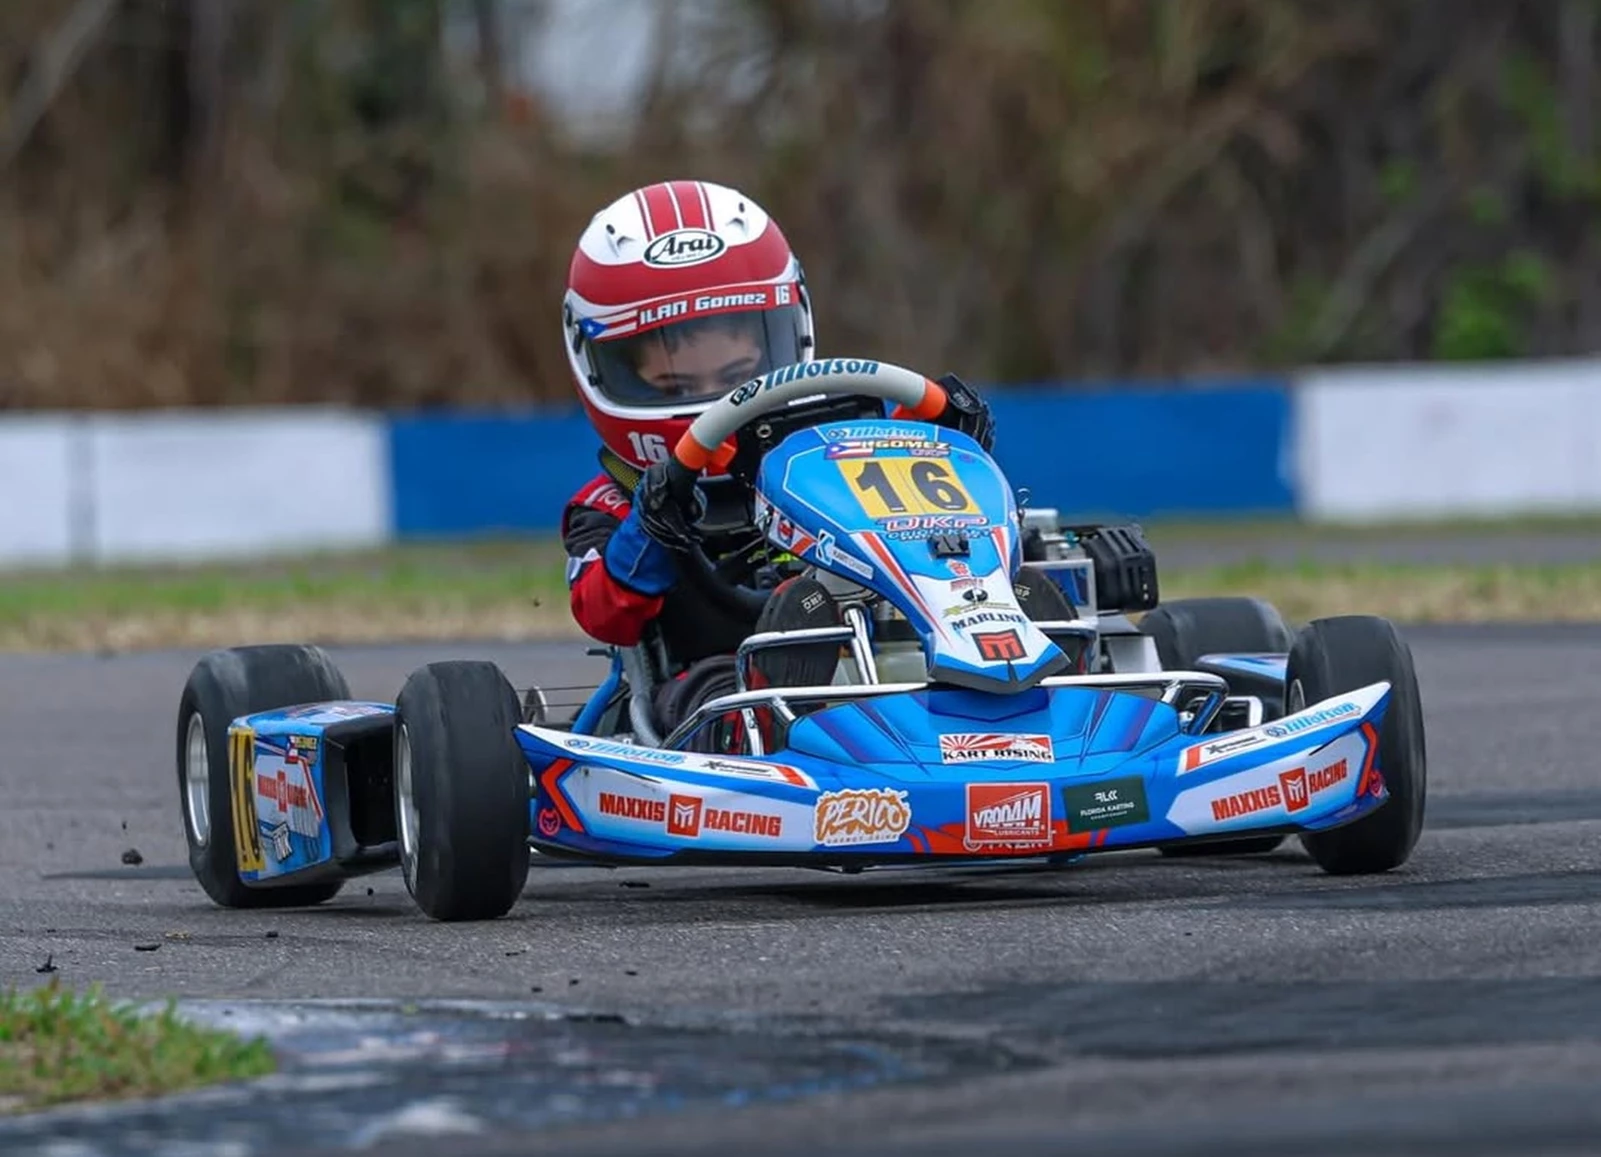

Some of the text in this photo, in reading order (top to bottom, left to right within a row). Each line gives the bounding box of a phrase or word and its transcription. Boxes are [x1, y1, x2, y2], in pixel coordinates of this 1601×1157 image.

[652, 235, 715, 261] Arai
[640, 300, 687, 325] ILAN
[775, 285, 791, 306] 16
[628, 431, 669, 464] 16
[855, 460, 969, 513] 16
[943, 748, 1052, 760] KART RISING
[1211, 785, 1281, 821] MAXXIS
[1309, 758, 1347, 794] RACING
[599, 792, 666, 822] MAXXIS
[704, 808, 782, 837] RACING
